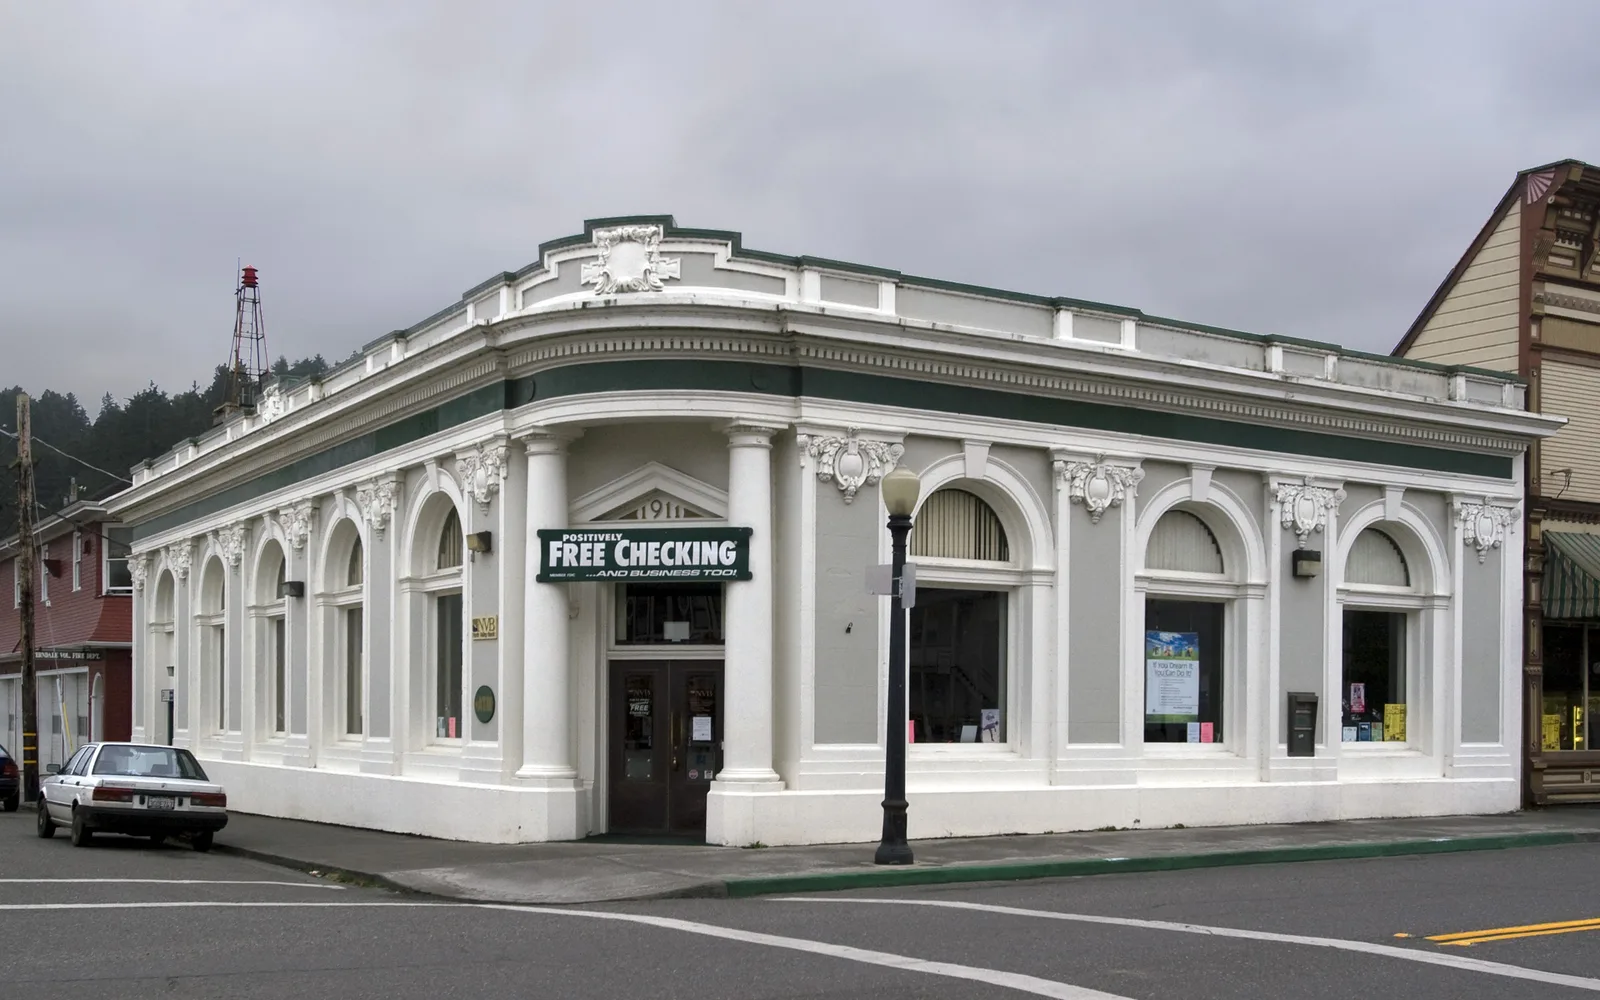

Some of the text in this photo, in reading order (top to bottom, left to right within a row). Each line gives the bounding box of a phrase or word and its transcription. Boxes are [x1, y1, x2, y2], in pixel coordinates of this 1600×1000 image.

[640, 499, 681, 519] 1911
[562, 533, 623, 542] POSITIVELY
[549, 539, 736, 567] FREE CHECKING
[629, 569, 701, 577] BUSINESS
[702, 569, 738, 577] TOO!
